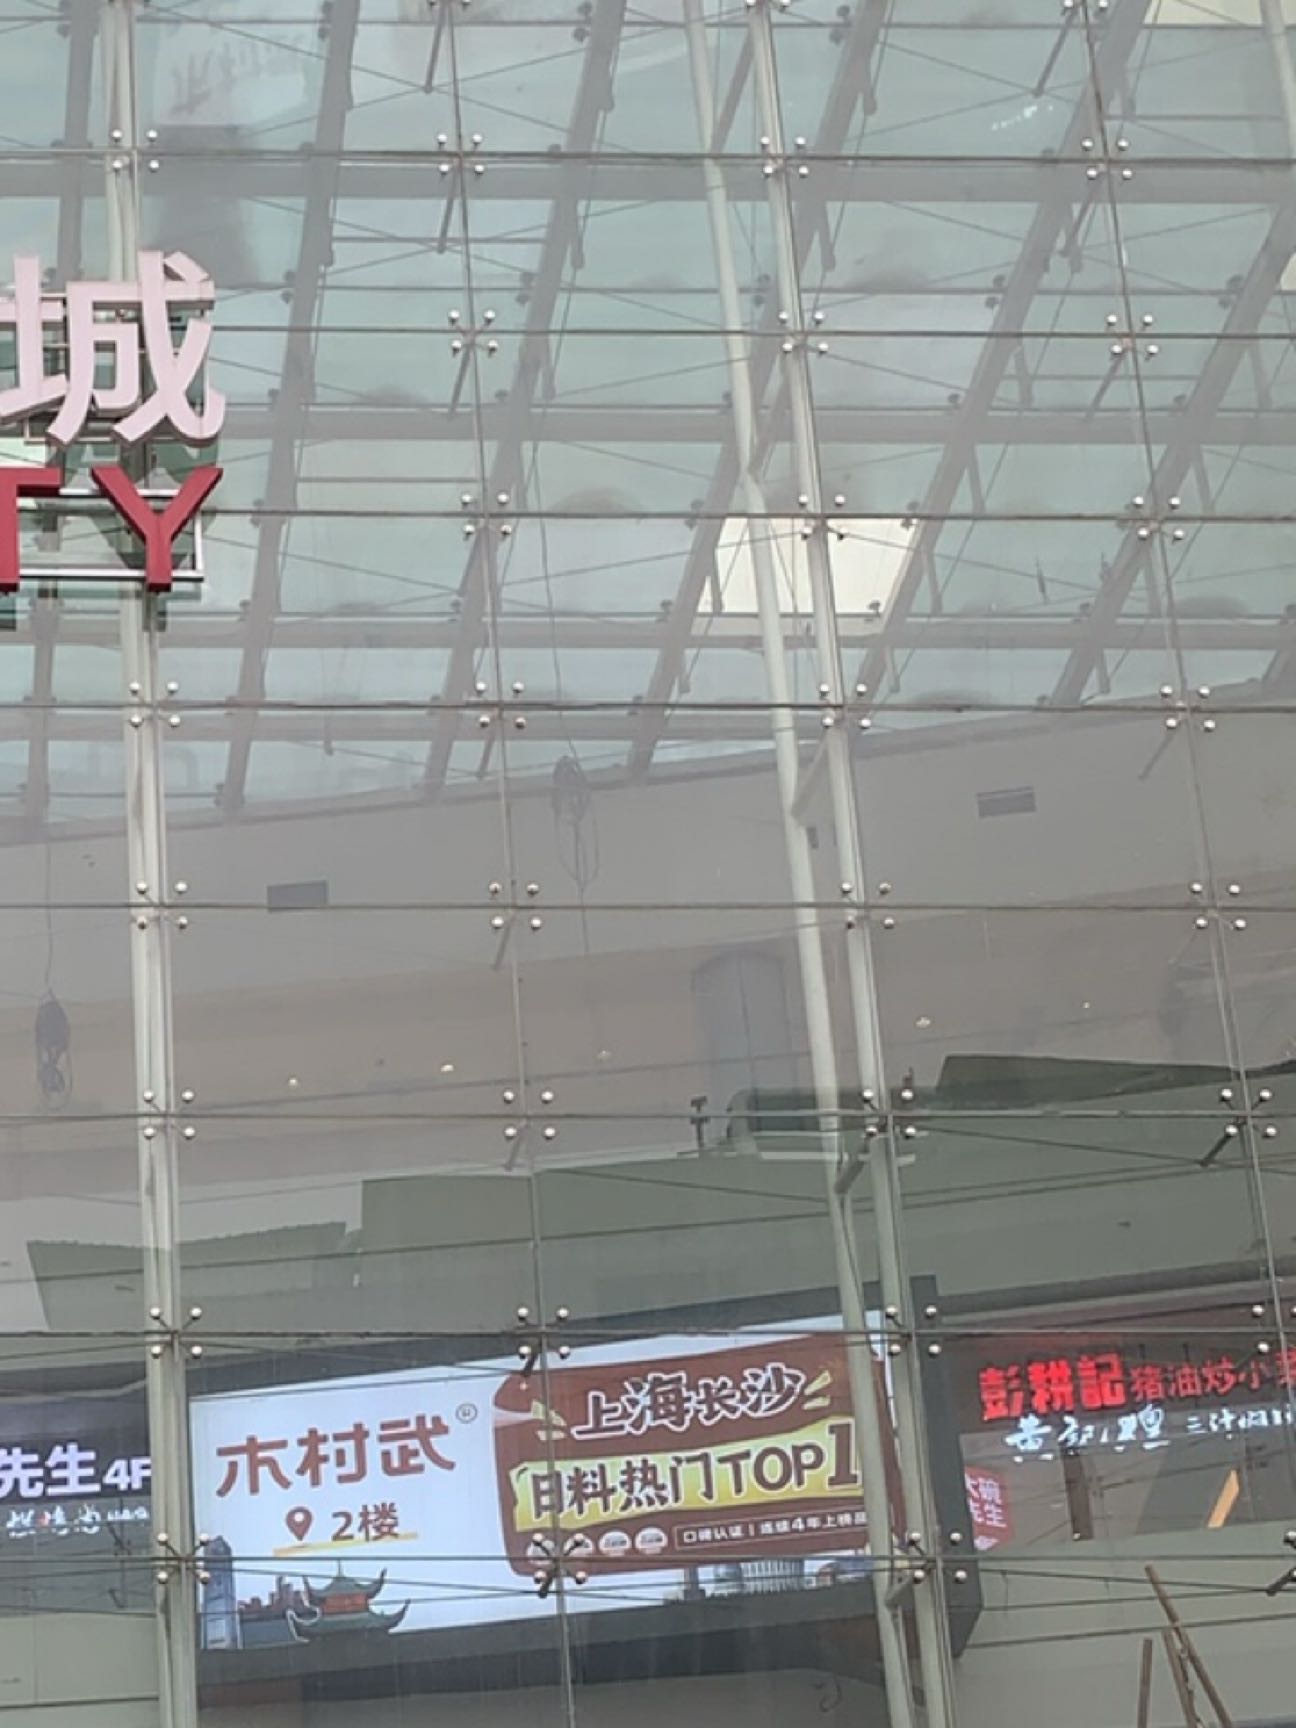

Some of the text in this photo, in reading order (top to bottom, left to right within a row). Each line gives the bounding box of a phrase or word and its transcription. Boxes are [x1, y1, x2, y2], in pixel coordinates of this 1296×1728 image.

[570, 1362, 807, 1440] 上海长沙
[215, 1413, 456, 1498] 木村武
[529, 1418, 861, 1521] 日料热门TOP1
[331, 1502, 400, 1542] 2楼
